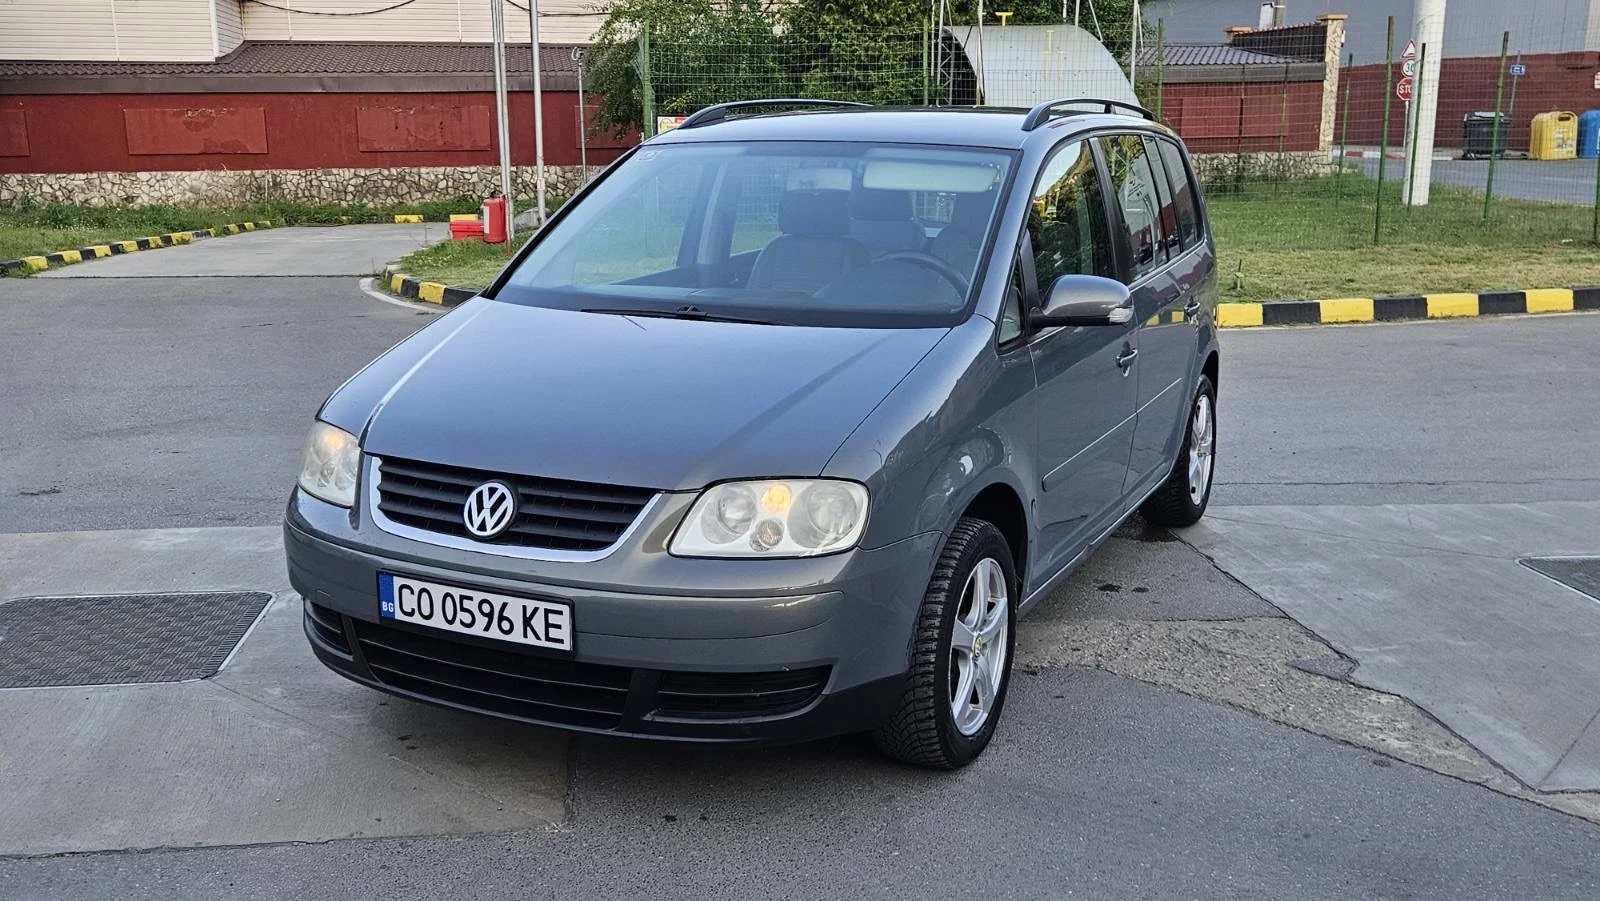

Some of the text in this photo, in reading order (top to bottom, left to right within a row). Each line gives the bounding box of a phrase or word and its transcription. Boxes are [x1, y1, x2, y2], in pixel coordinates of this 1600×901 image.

[1399, 84, 1412, 94] STO
[463, 482, 514, 537] VW
[382, 601, 394, 612] BG
[398, 583, 565, 645] CO 0596 KE
